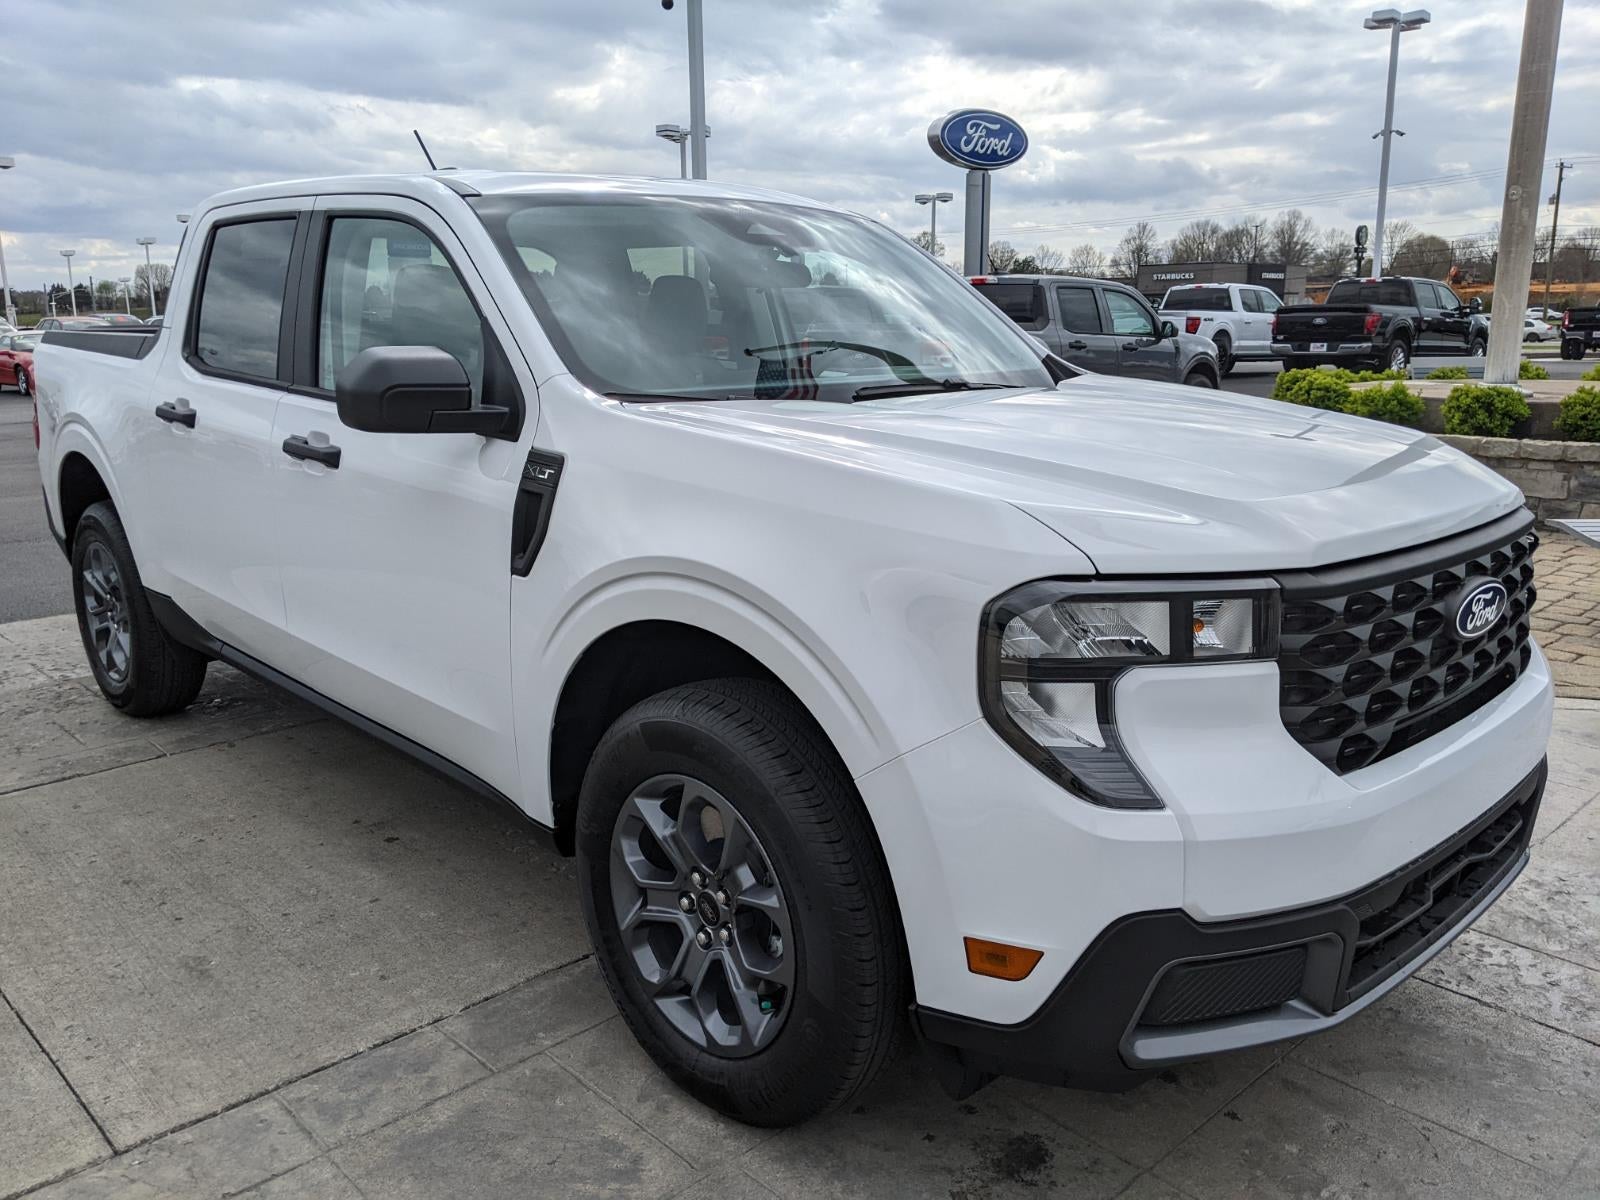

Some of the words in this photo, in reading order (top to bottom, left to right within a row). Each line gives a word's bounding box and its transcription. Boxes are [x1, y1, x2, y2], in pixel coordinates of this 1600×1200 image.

[960, 119, 1013, 156] Ford
[1153, 272, 1195, 280] STARBUCKS
[527, 464, 555, 479] XLT
[1466, 590, 1499, 630] Ford
